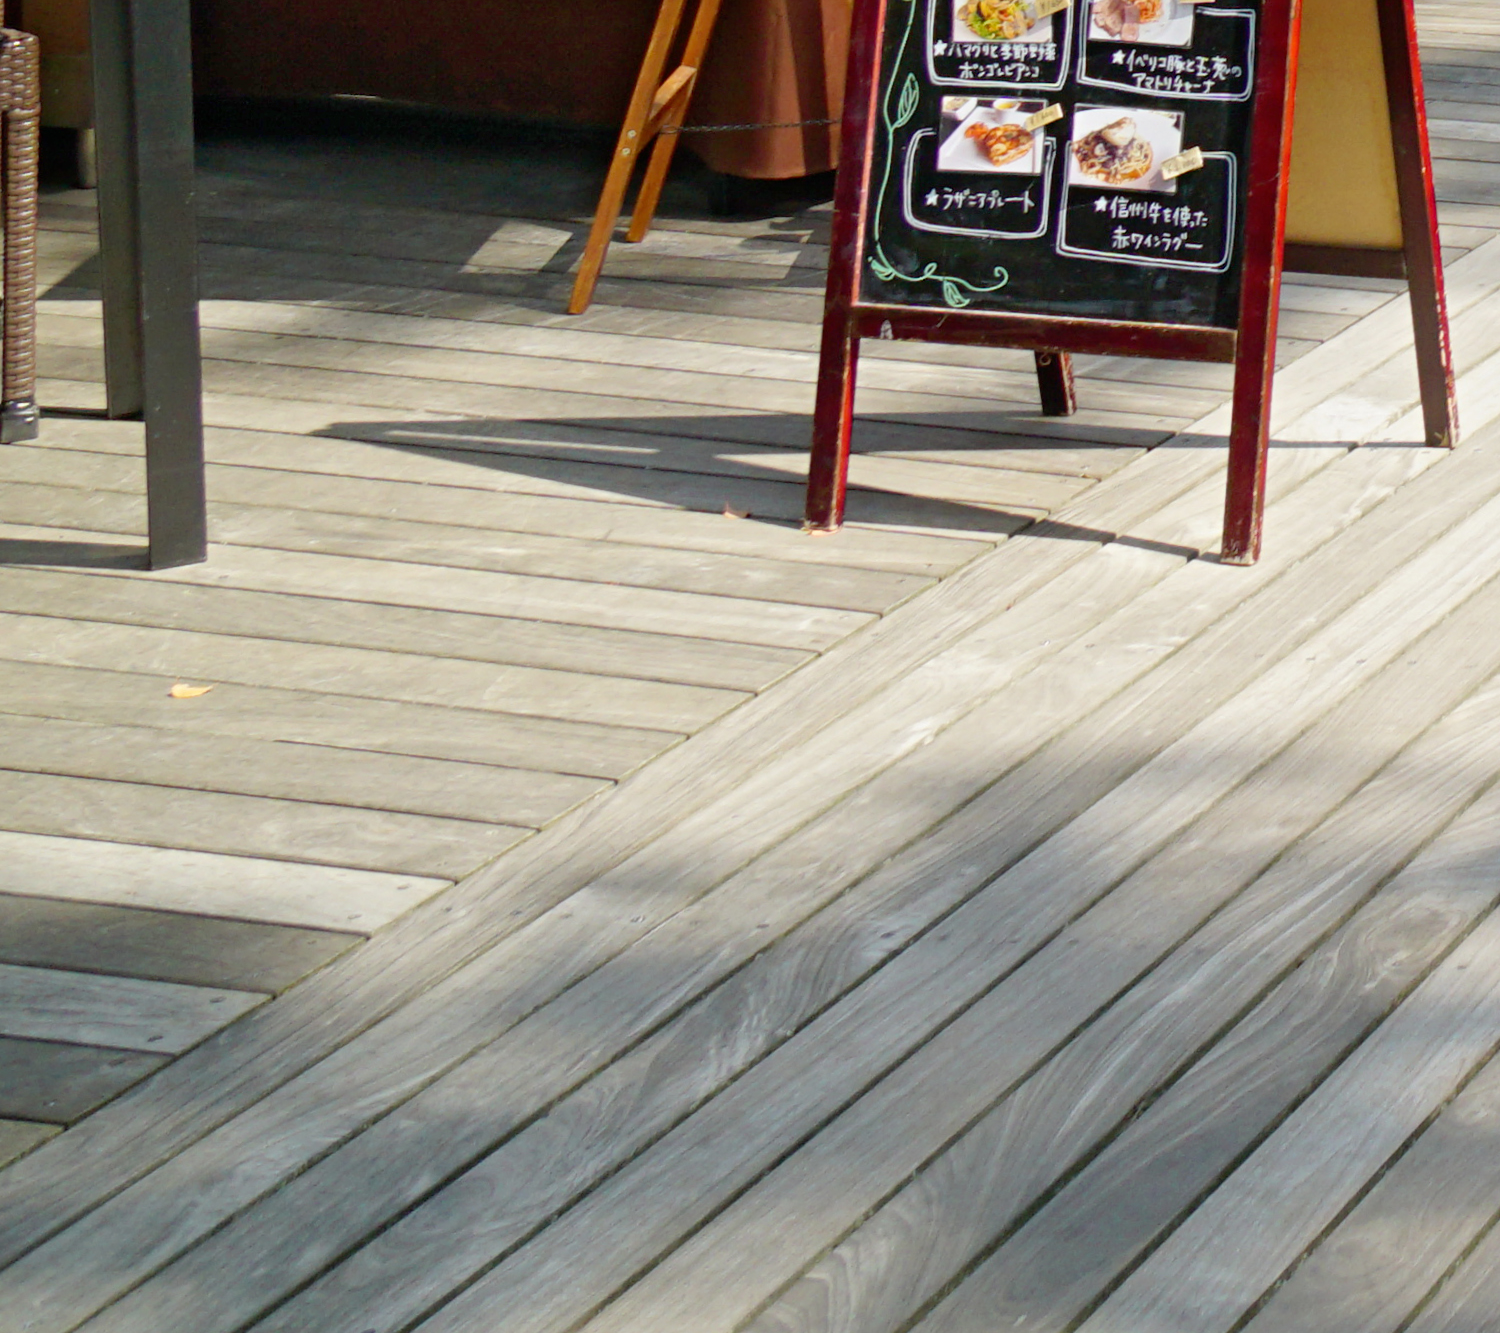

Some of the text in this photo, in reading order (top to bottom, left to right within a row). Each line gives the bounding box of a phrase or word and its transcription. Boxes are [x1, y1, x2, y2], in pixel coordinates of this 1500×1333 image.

[1110, 195, 1209, 228] 信州牛を使った
